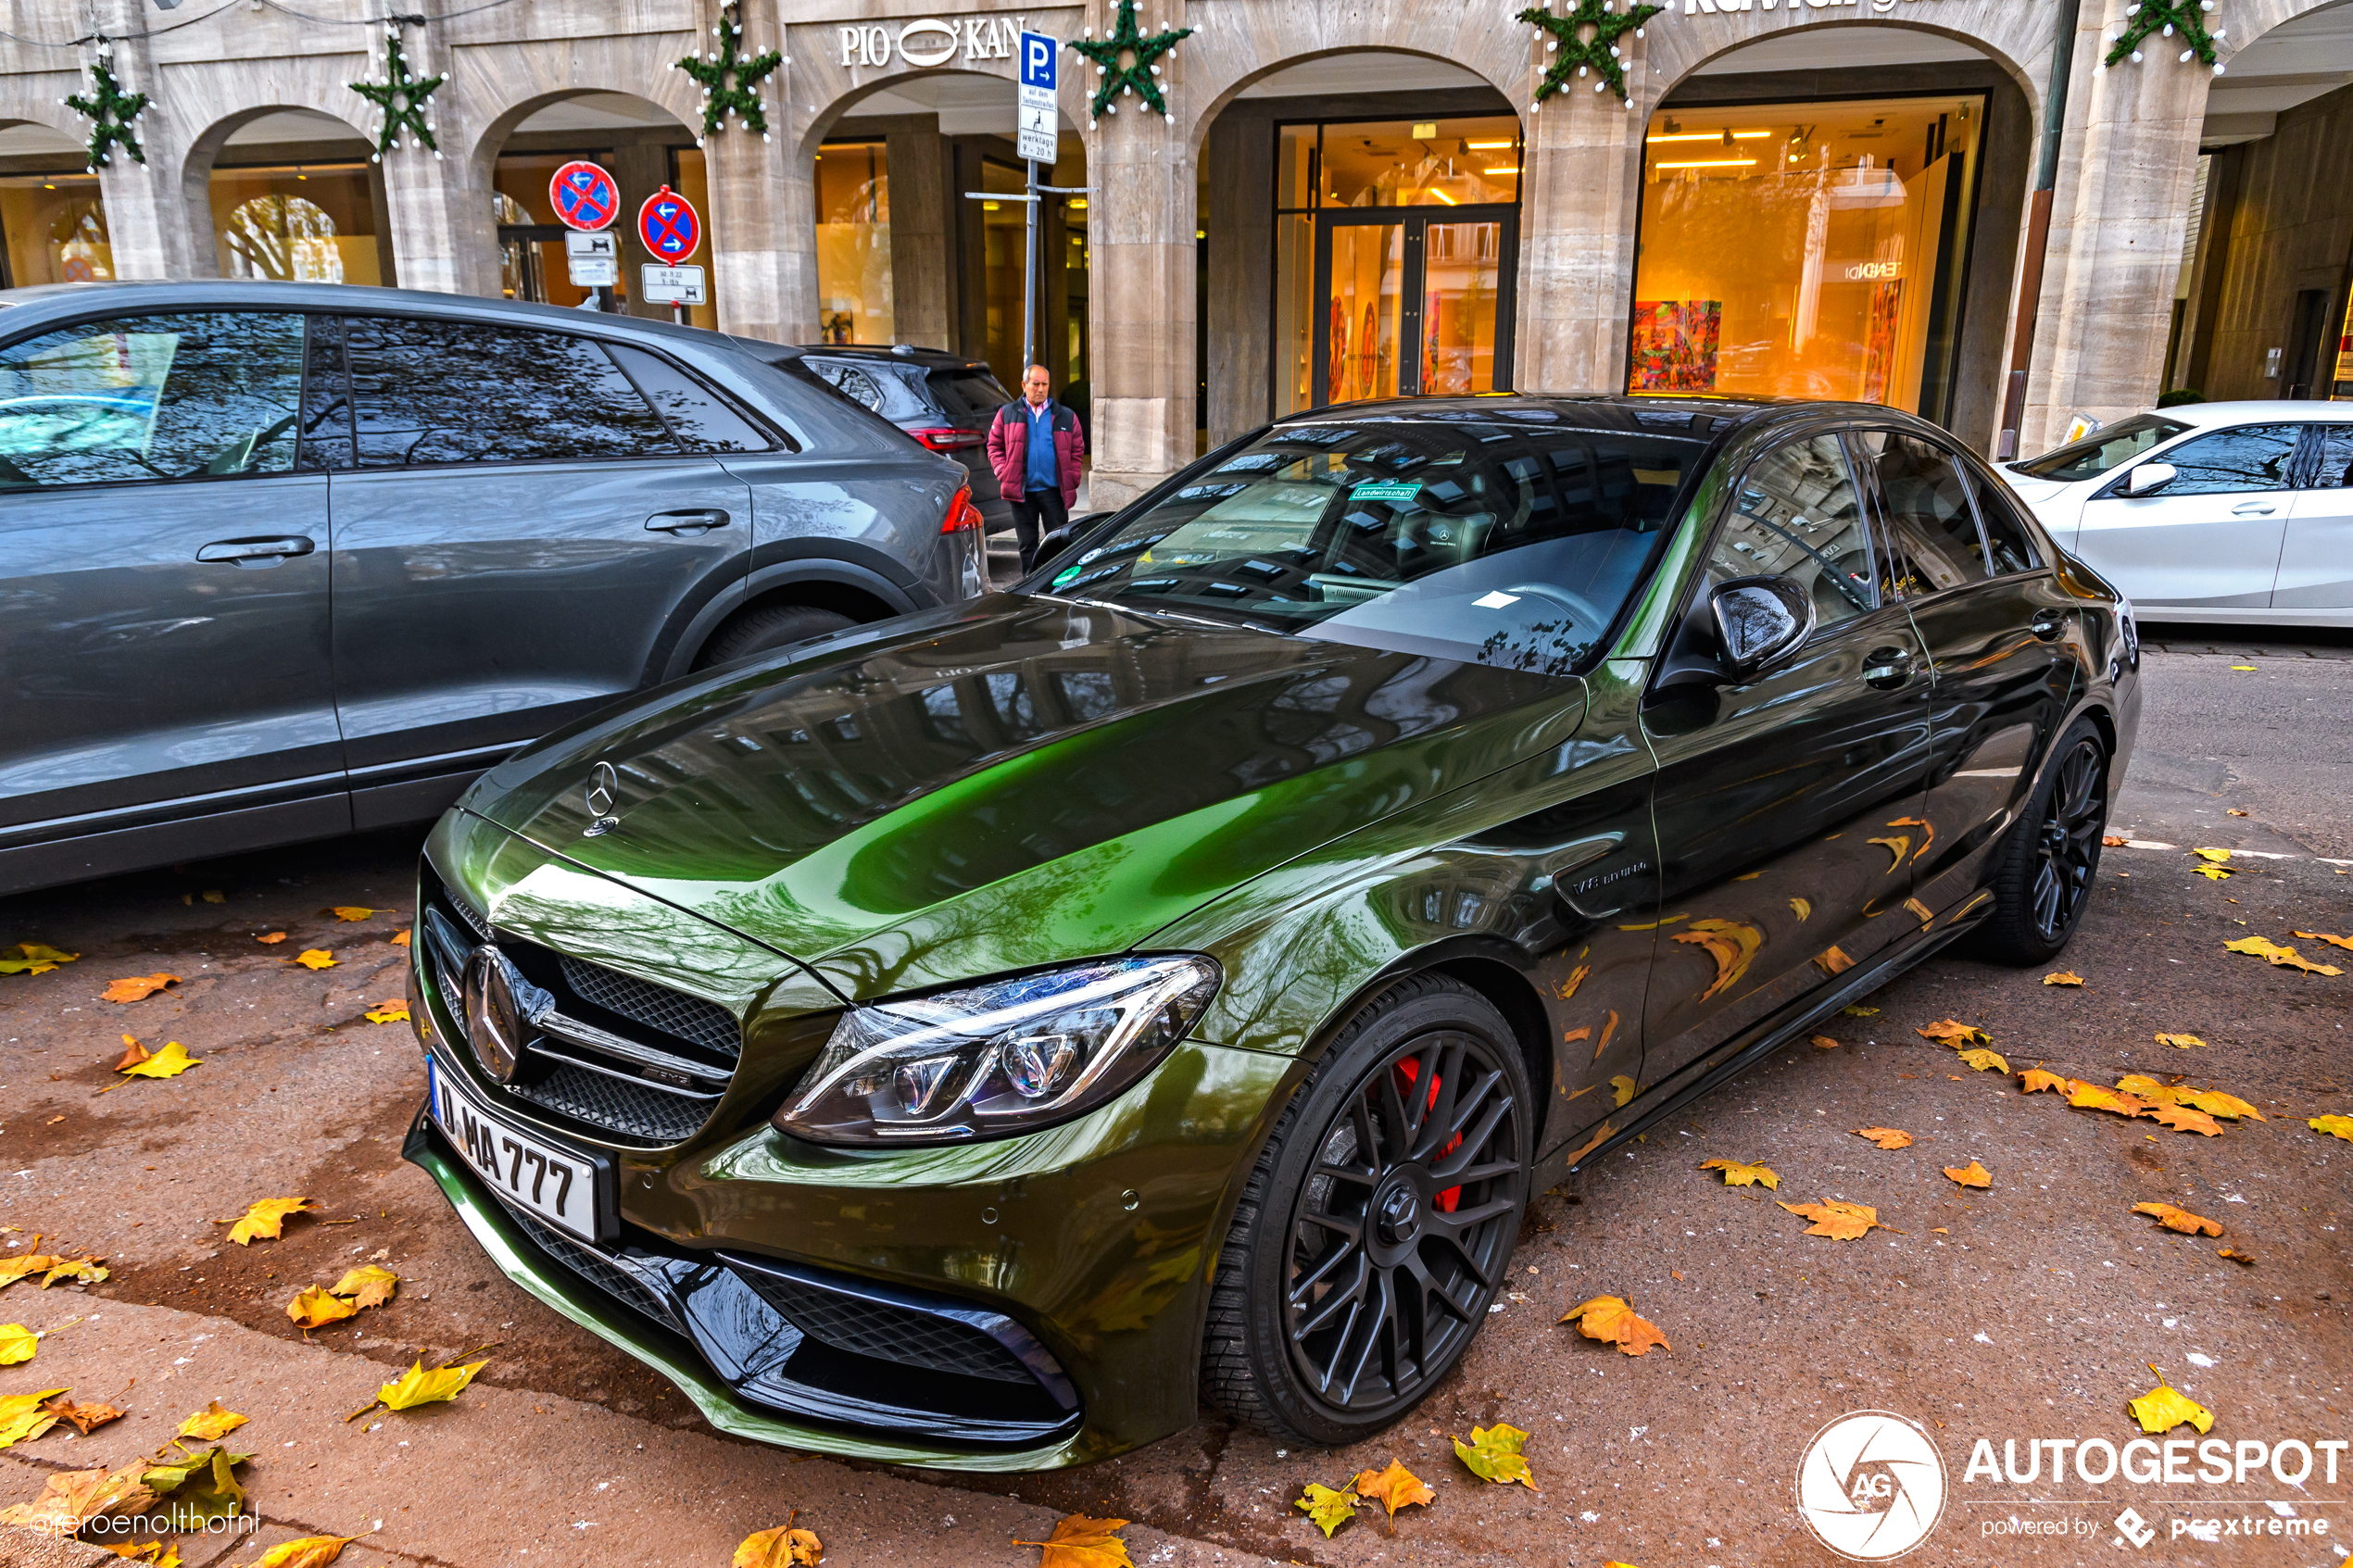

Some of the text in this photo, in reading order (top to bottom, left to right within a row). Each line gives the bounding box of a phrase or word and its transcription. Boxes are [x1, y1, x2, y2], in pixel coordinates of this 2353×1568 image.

[839, 26, 890, 67] PIO
[1028, 39, 1049, 82] P
[1028, 87, 1049, 98] auf dem
[1023, 95, 1054, 109] Seitenstreifen
[1022, 132, 1054, 147] werktags
[1023, 144, 1027, 153] 9
[1037, 146, 1045, 157] 20
[1348, 353, 1384, 361] SETAREH
[1356, 489, 1412, 497] Landwirtschaft
[1572, 861, 1646, 897] V8 BITURBO
[439, 1078, 573, 1217] D MA 777
